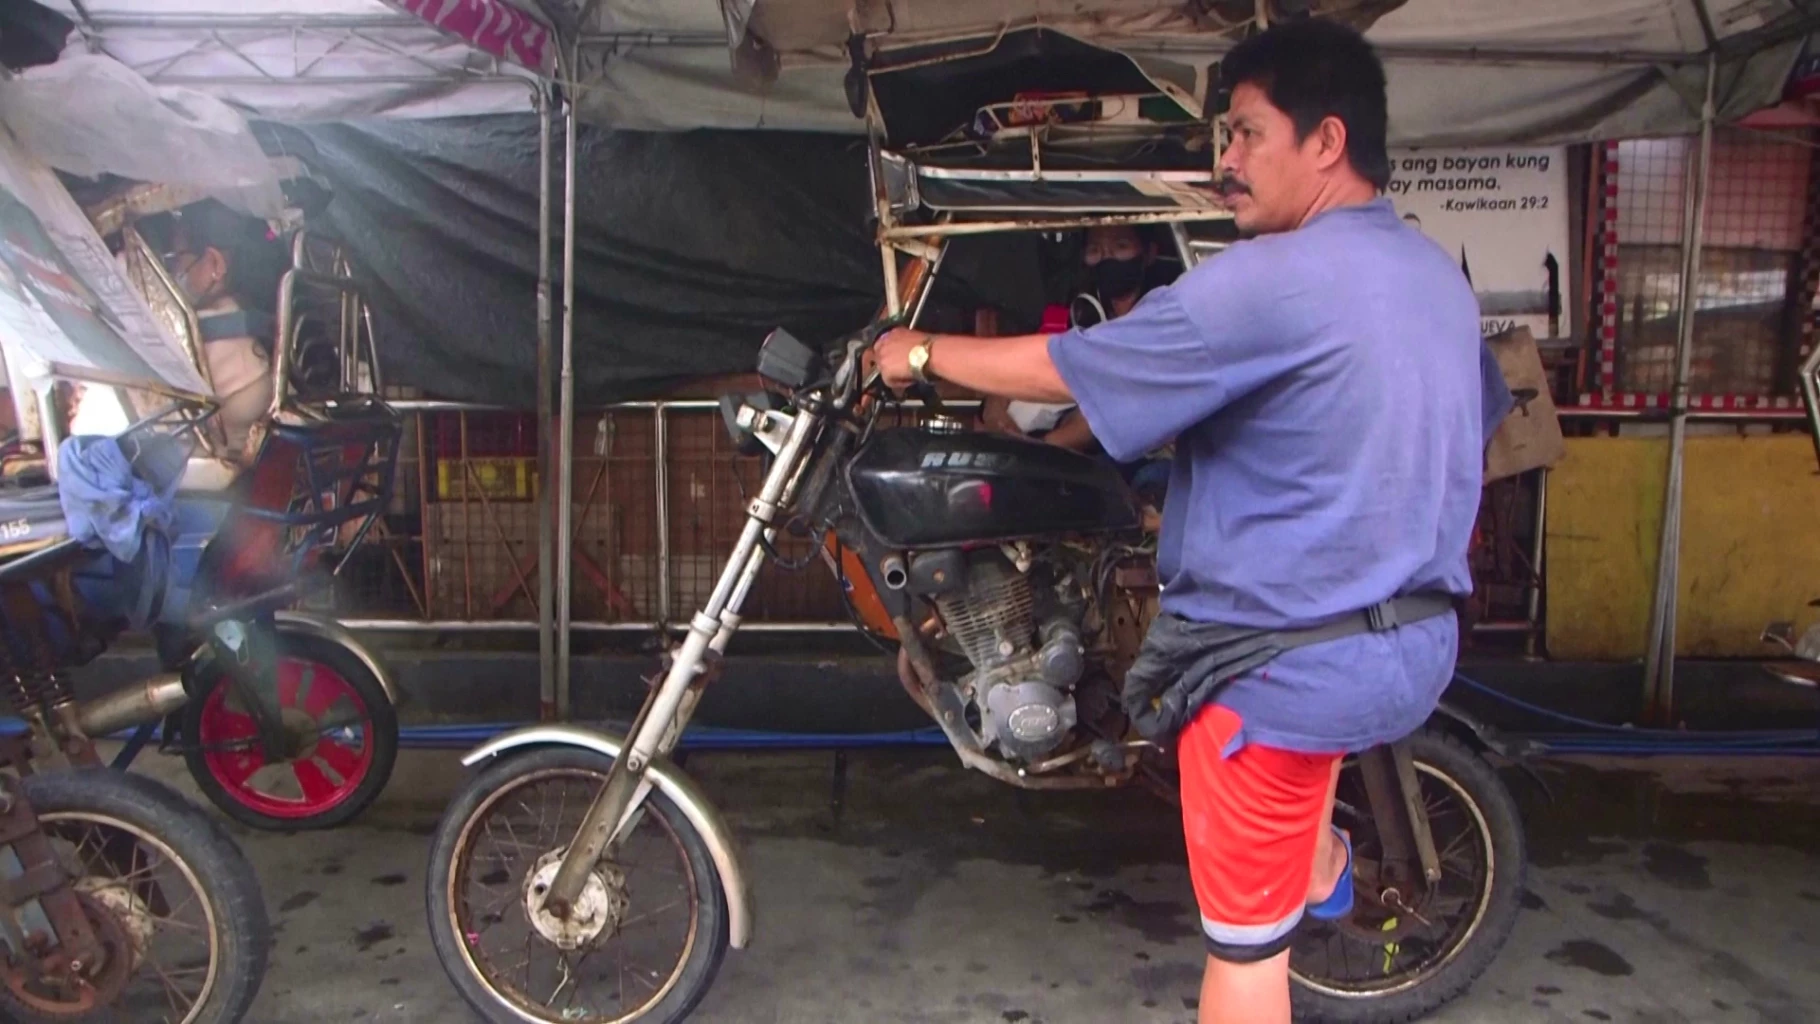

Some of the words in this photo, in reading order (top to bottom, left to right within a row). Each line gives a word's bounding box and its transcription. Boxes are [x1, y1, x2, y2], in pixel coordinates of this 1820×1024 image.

[1402, 157, 1437, 173] ang
[1443, 154, 1501, 172] bayan
[1506, 153, 1549, 171] kung
[1417, 177, 1501, 192] masama.
[1440, 196, 1516, 212] -Kawikaan
[1520, 196, 1549, 209] 29:2
[1480, 319, 1515, 334] UEVA
